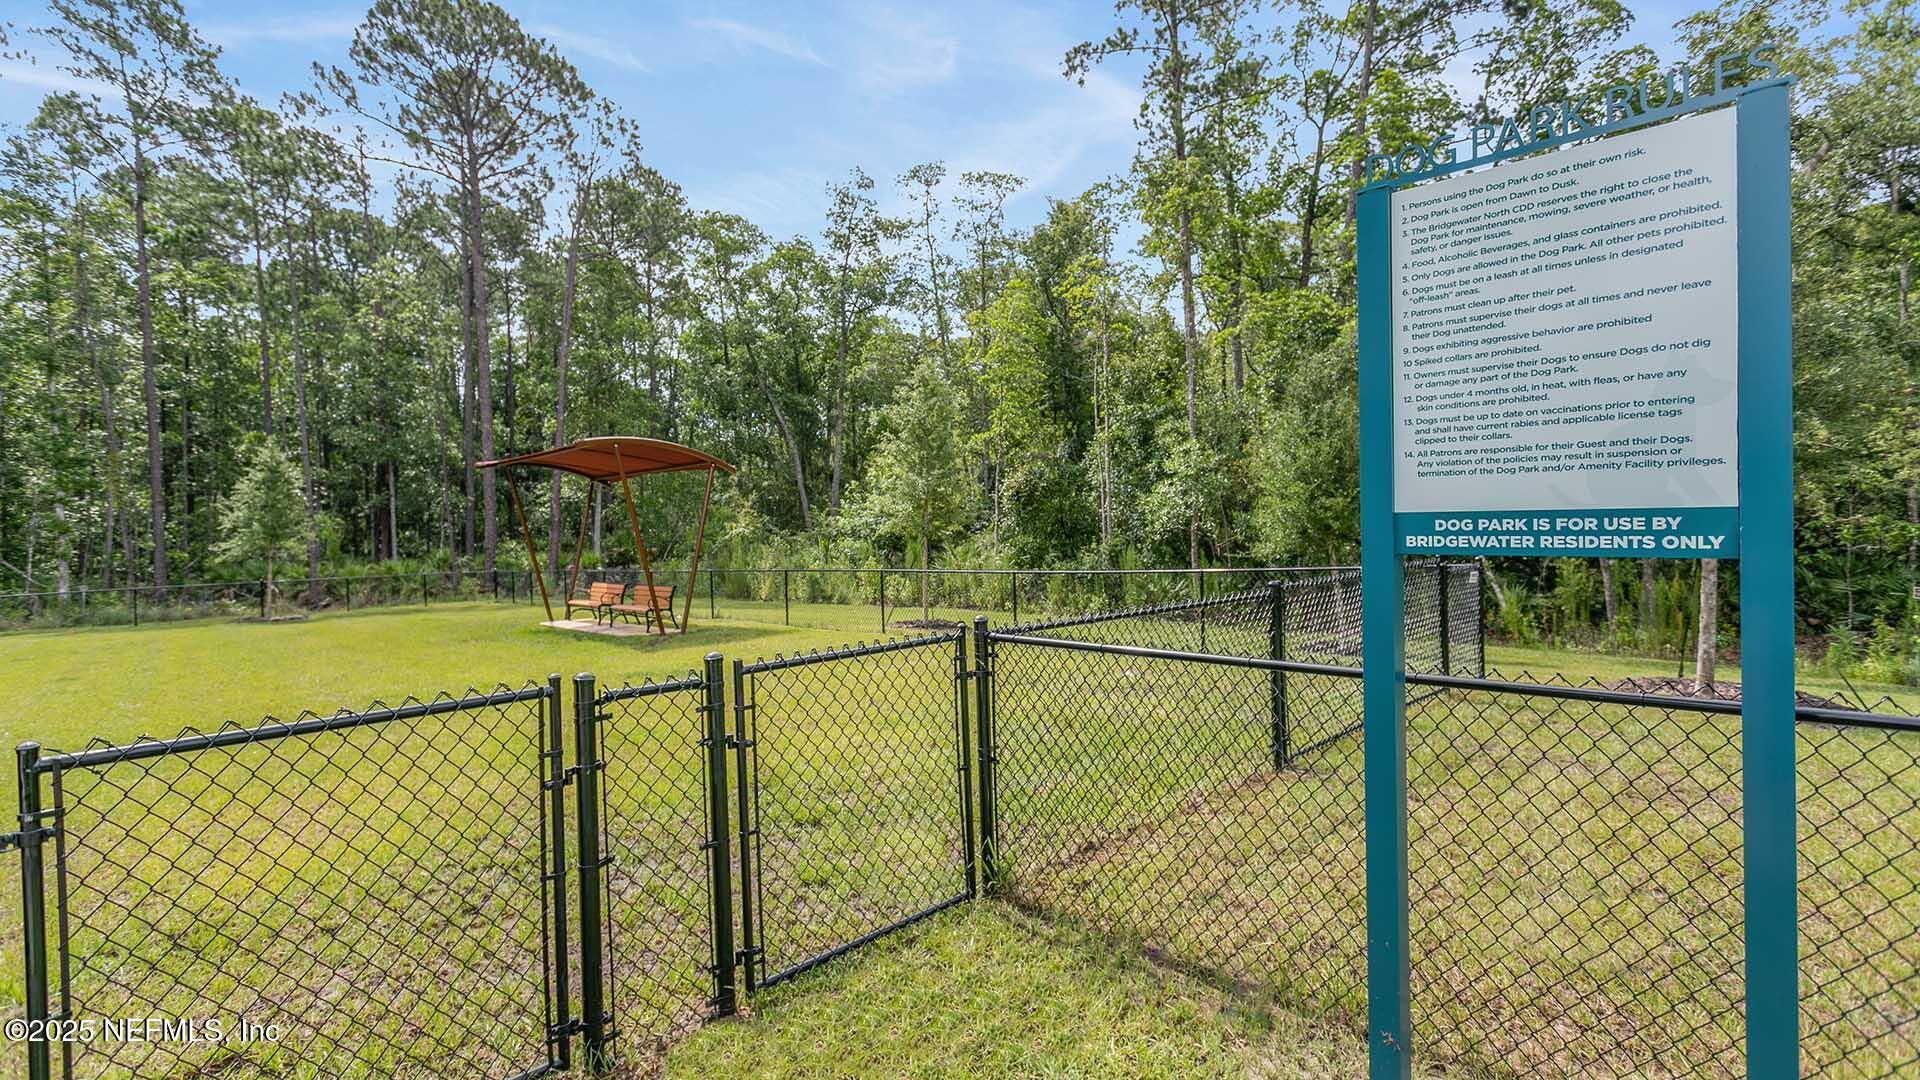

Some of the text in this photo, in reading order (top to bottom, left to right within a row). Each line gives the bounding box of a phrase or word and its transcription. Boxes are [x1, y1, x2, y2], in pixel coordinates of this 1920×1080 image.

[1367, 43, 1778, 185] DOG PARK RULES
[1409, 197, 1442, 210] Persons
[1443, 191, 1467, 201] using
[1468, 187, 1483, 195] the
[1485, 181, 1505, 191] Dog
[1507, 175, 1529, 186] Park
[1530, 172, 1544, 180] do
[1545, 169, 1558, 177] so
[1560, 165, 1570, 174] at
[1572, 159, 1596, 170] their
[1598, 154, 1621, 164] own
[1624, 147, 1646, 158] risk.
[1410, 213, 1428, 222] Dog
[1430, 207, 1450, 218] Park
[1460, 201, 1483, 211] open
[1484, 195, 1507, 205] from
[1509, 188, 1537, 200] Dawn
[1551, 178, 1579, 190] Dusk.
[1410, 227, 1426, 235] The
[1428, 215, 1482, 232] Bridgewater
[1483, 207, 1510, 220] North
[1512, 202, 1535, 213] CDD
[1536, 193, 1578, 208] reserves
[1579, 190, 1597, 198] the
[1599, 182, 1626, 194] right
[1626, 180, 1639, 188] to
[1641, 173, 1671, 184] close
[1673, 168, 1692, 178] the
[1411, 272, 1430, 281] Only
[1432, 268, 1455, 277] Dogs
[1457, 265, 1471, 273] are
[1472, 256, 1508, 270] allowed
[1509, 255, 1518, 263] in
[1520, 252, 1536, 261] the
[1538, 248, 1559, 258] Dog
[1561, 242, 1587, 253] Park.
[1588, 238, 1603, 248] All
[1605, 234, 1634, 245] other
[1636, 229, 1662, 241] pets
[1663, 215, 1727, 236] prohibited.
[1411, 307, 1442, 317] Patrons
[1443, 302, 1466, 312] must
[1467, 299, 1491, 308] clean
[1493, 297, 1506, 305] up
[1507, 293, 1530, 302] after
[1531, 288, 1554, 298] their
[1556, 285, 1576, 296] pet.
[1412, 345, 1434, 353] Dogs
[1436, 339, 1478, 350] exhibiting
[1480, 332, 1529, 345] aggressive
[1531, 326, 1575, 337] behavior
[1577, 323, 1594, 331] are
[1596, 313, 1651, 330] prohibited
[1413, 370, 1446, 379] Owners
[1447, 366, 1470, 375] must
[1470, 362, 1514, 373] supervise
[1516, 358, 1538, 367] their
[1540, 356, 1567, 365] Dogs
[1582, 350, 1617, 360] ensure
[1619, 346, 1649, 355] Dogs
[1650, 343, 1666, 352] do
[1668, 341, 1689, 350] not
[1692, 338, 1710, 348] dig
[1424, 379, 1460, 388] damage
[1461, 376, 1478, 384] any
[1479, 374, 1499, 384] part
[1500, 371, 1511, 380] of
[1512, 370, 1528, 378] the
[1530, 368, 1551, 376] Dog
[1553, 364, 1578, 374] Park.
[1414, 409, 1683, 435] and shall have current rabies and applicable license tags
[1416, 418, 1438, 426] Dogs
[1439, 415, 1461, 423] must
[1502, 410, 1523, 418] date
[1540, 404, 1602, 414] vaccinations
[1605, 400, 1630, 411] prior
[1647, 395, 1694, 406] entering
[1414, 435, 1446, 445] clipped
[1458, 433, 1479, 442] their
[1480, 432, 1512, 440] collars.
[1416, 450, 1428, 458] All
[1479, 444, 1533, 455] responsible
[1550, 441, 1574, 450] their
[1576, 440, 1606, 448] Guest
[1608, 438, 1629, 446] and
[1631, 436, 1657, 445] their
[1660, 436, 1693, 444] Dogs.
[1416, 460, 1434, 468] Any
[1435, 458, 1472, 466] violation
[1485, 456, 1501, 464] the
[1502, 454, 1539, 465] policies
[1540, 454, 1562, 462] may
[1564, 451, 1593, 460] result
[1594, 450, 1604, 458] in
[1606, 447, 1667, 459] suspension
[1416, 468, 1466, 477] termination
[1467, 467, 1478, 475] of
[1496, 466, 1516, 474] Dog
[1518, 464, 1540, 472] Park
[1541, 462, 1575, 472] and/or
[1577, 461, 1622, 470] Amenity
[1624, 459, 1664, 468] Facility
[1666, 457, 1726, 468] privileges.
[1435, 516, 1682, 532] DOG PARK IS FOR USE BY
[1406, 535, 1725, 549] BRIDGEWATER RESIDENTS ONLY
